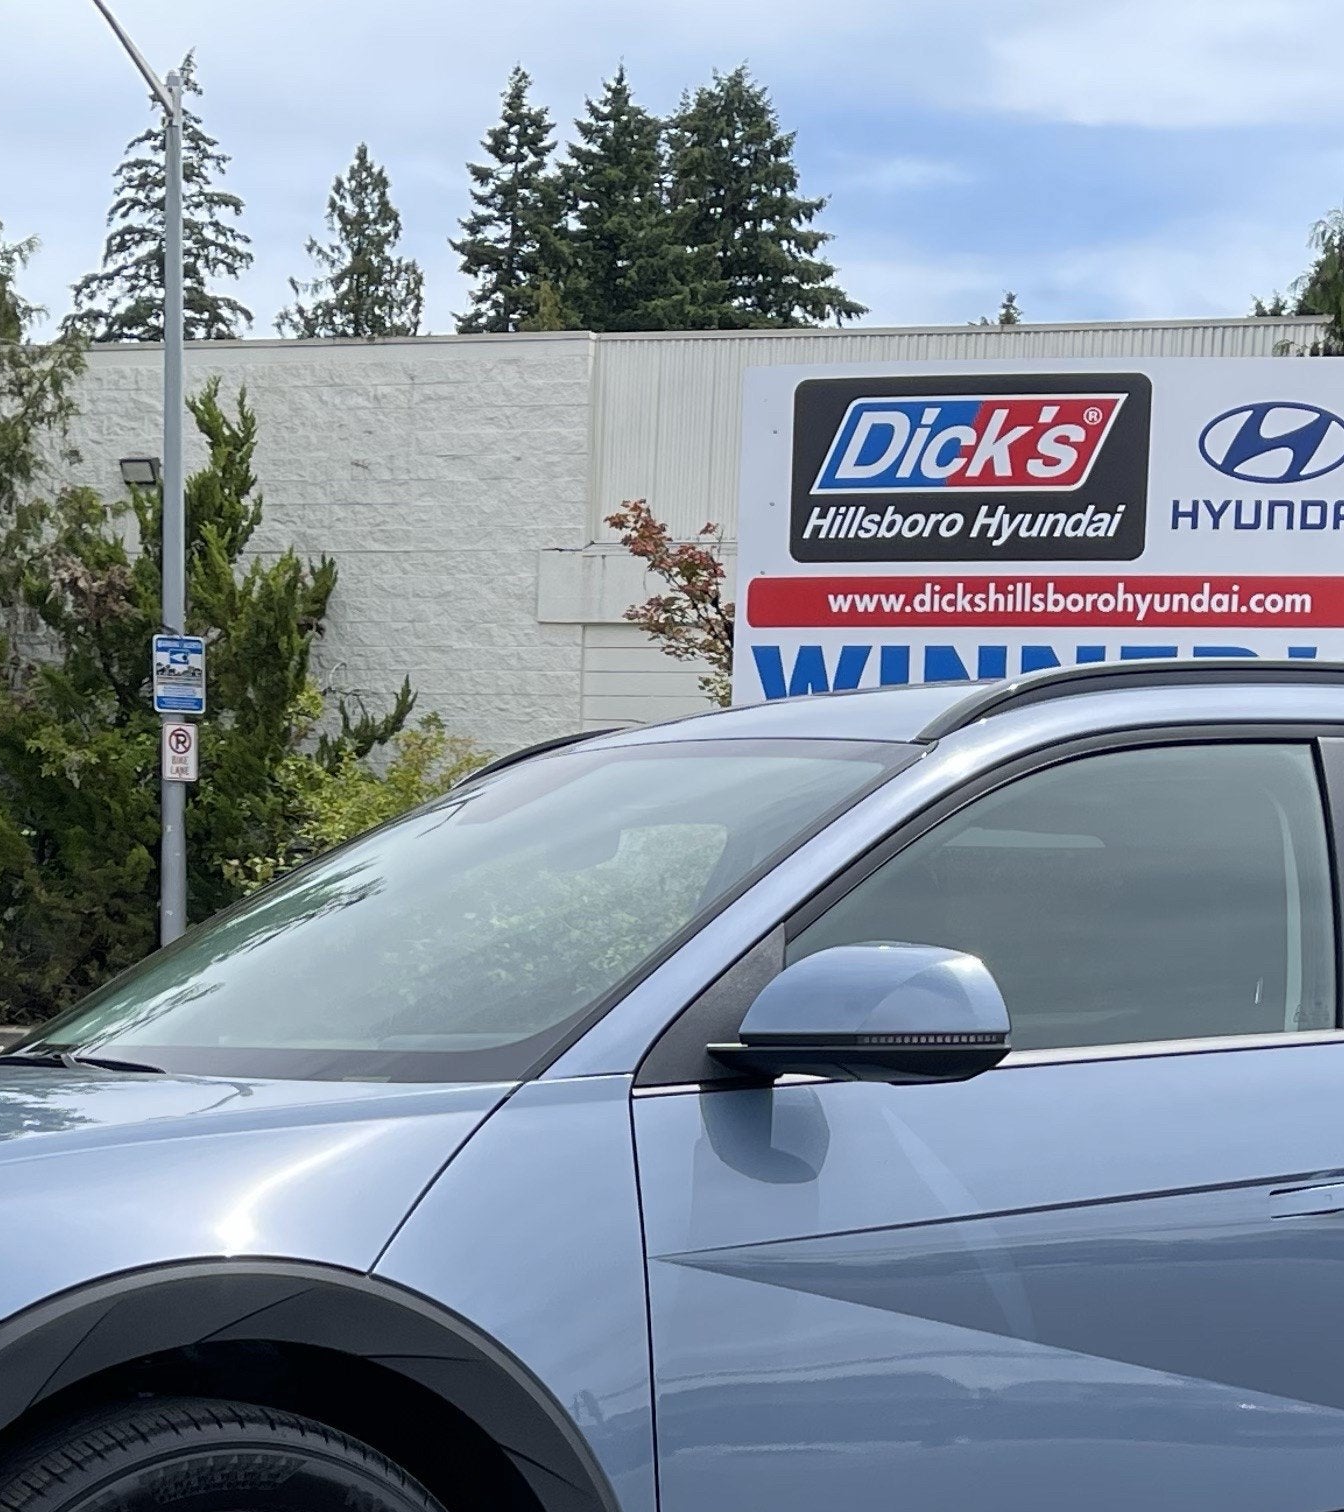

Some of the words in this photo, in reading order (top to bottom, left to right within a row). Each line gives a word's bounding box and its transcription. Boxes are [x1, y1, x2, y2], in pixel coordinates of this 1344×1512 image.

[802, 505, 964, 541] Hillsboro
[970, 504, 1126, 546] Hyundai
[828, 582, 1311, 622] www.dickshillsborohyundai.com
